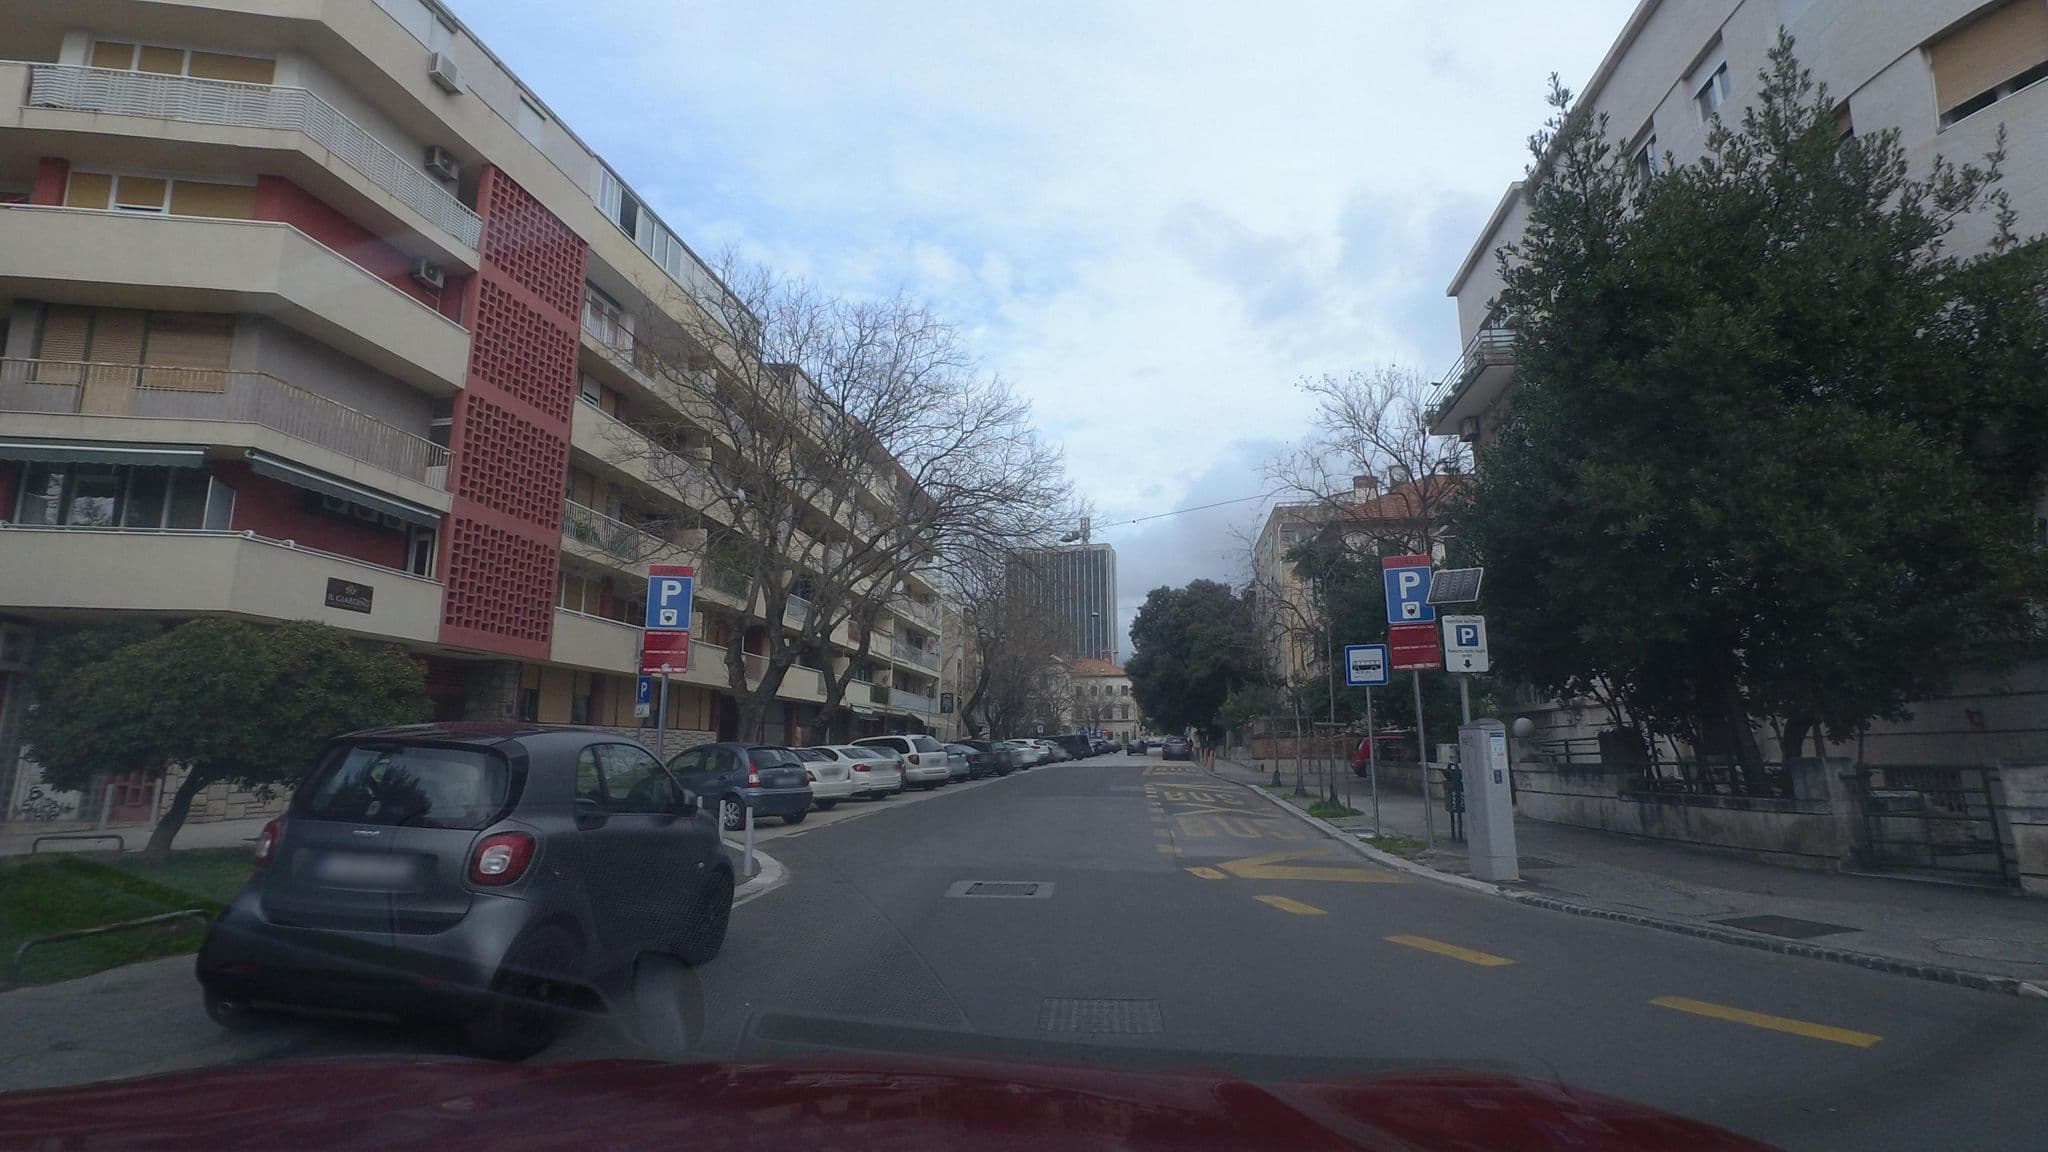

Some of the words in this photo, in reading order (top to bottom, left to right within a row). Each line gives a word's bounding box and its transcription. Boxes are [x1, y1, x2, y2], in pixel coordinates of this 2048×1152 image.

[660, 580, 682, 606] P
[1399, 571, 1420, 599] P
[1461, 627, 1474, 644] P
[639, 681, 648, 698] P
[1163, 791, 1244, 804] BUS
